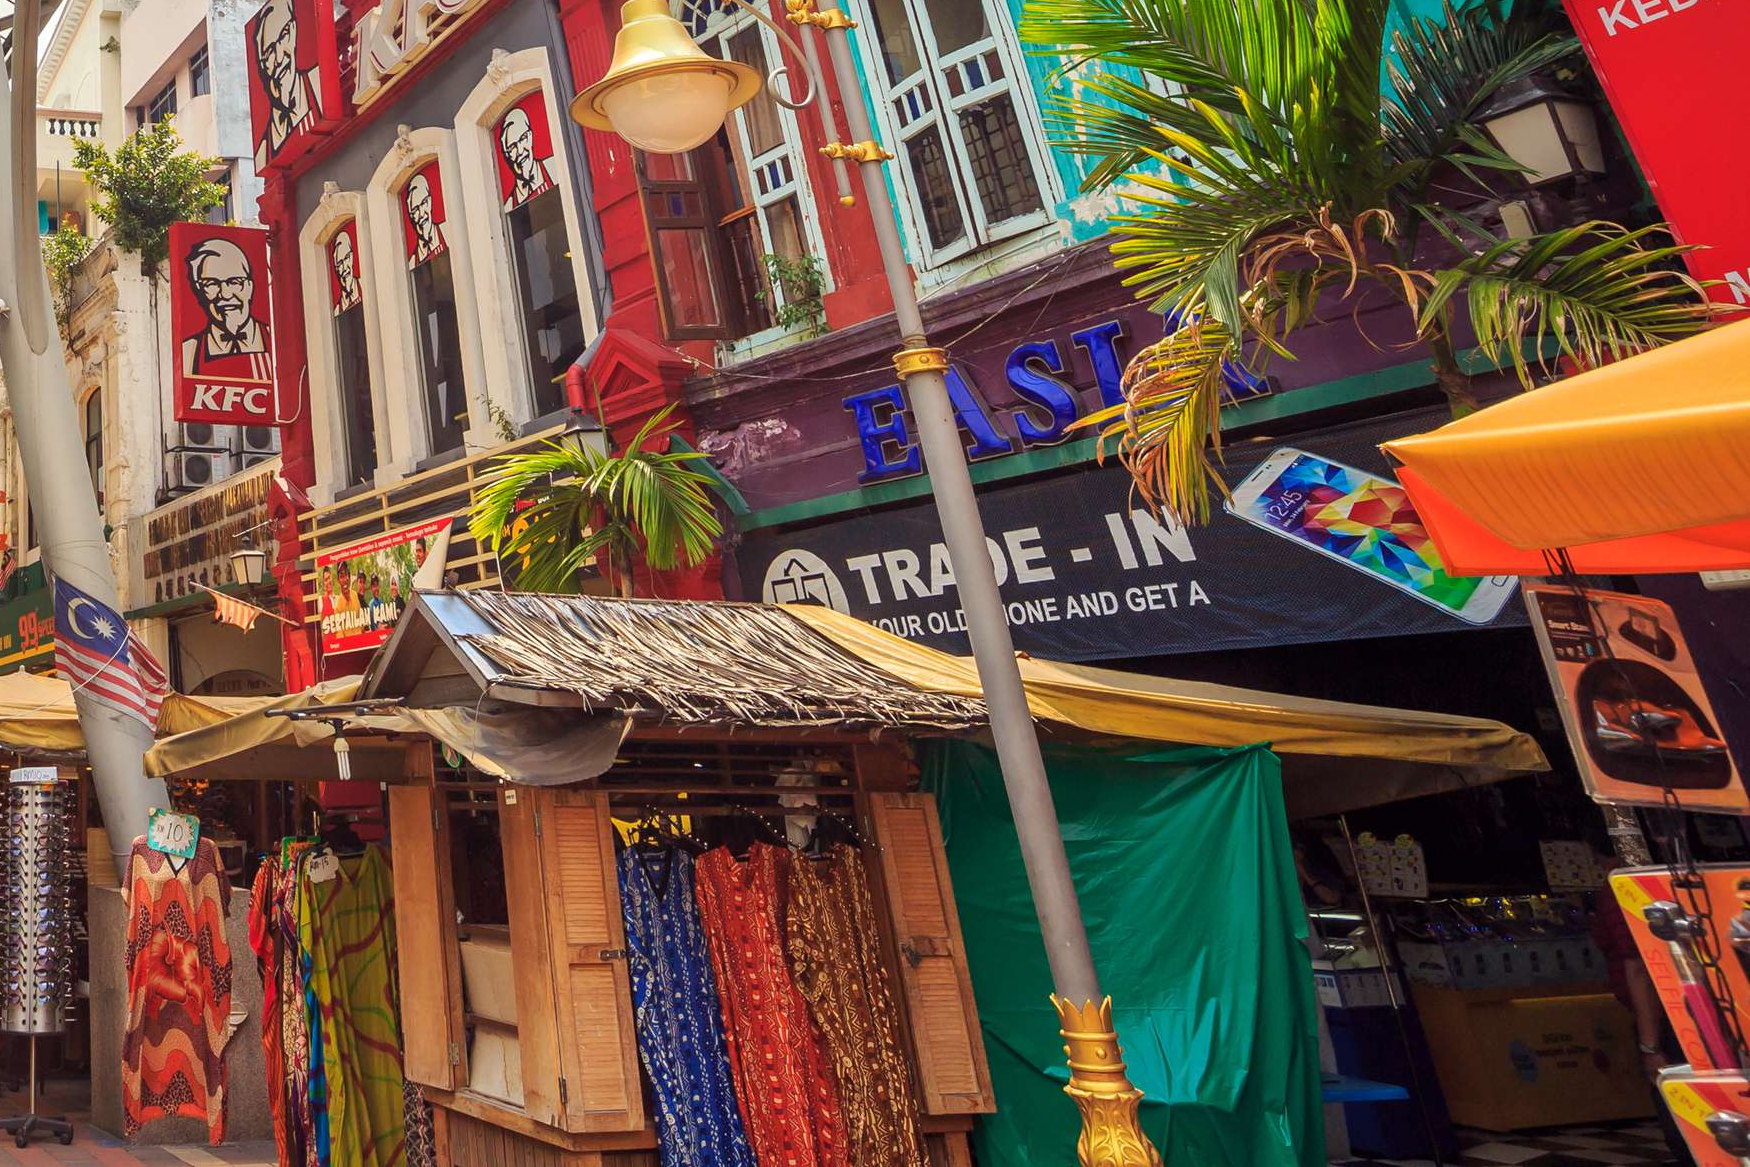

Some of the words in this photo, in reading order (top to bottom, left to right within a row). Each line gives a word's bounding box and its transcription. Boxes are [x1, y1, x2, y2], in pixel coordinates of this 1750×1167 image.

[190, 384, 268, 414] KFC
[1265, 490, 1302, 520] 12:45
[1105, 506, 1197, 570] IN
[865, 613, 925, 639] OUR
[1066, 590, 1119, 620] AND
[1125, 582, 1178, 612] GET
[1189, 580, 1211, 607] A
[167, 822, 184, 843] 10
